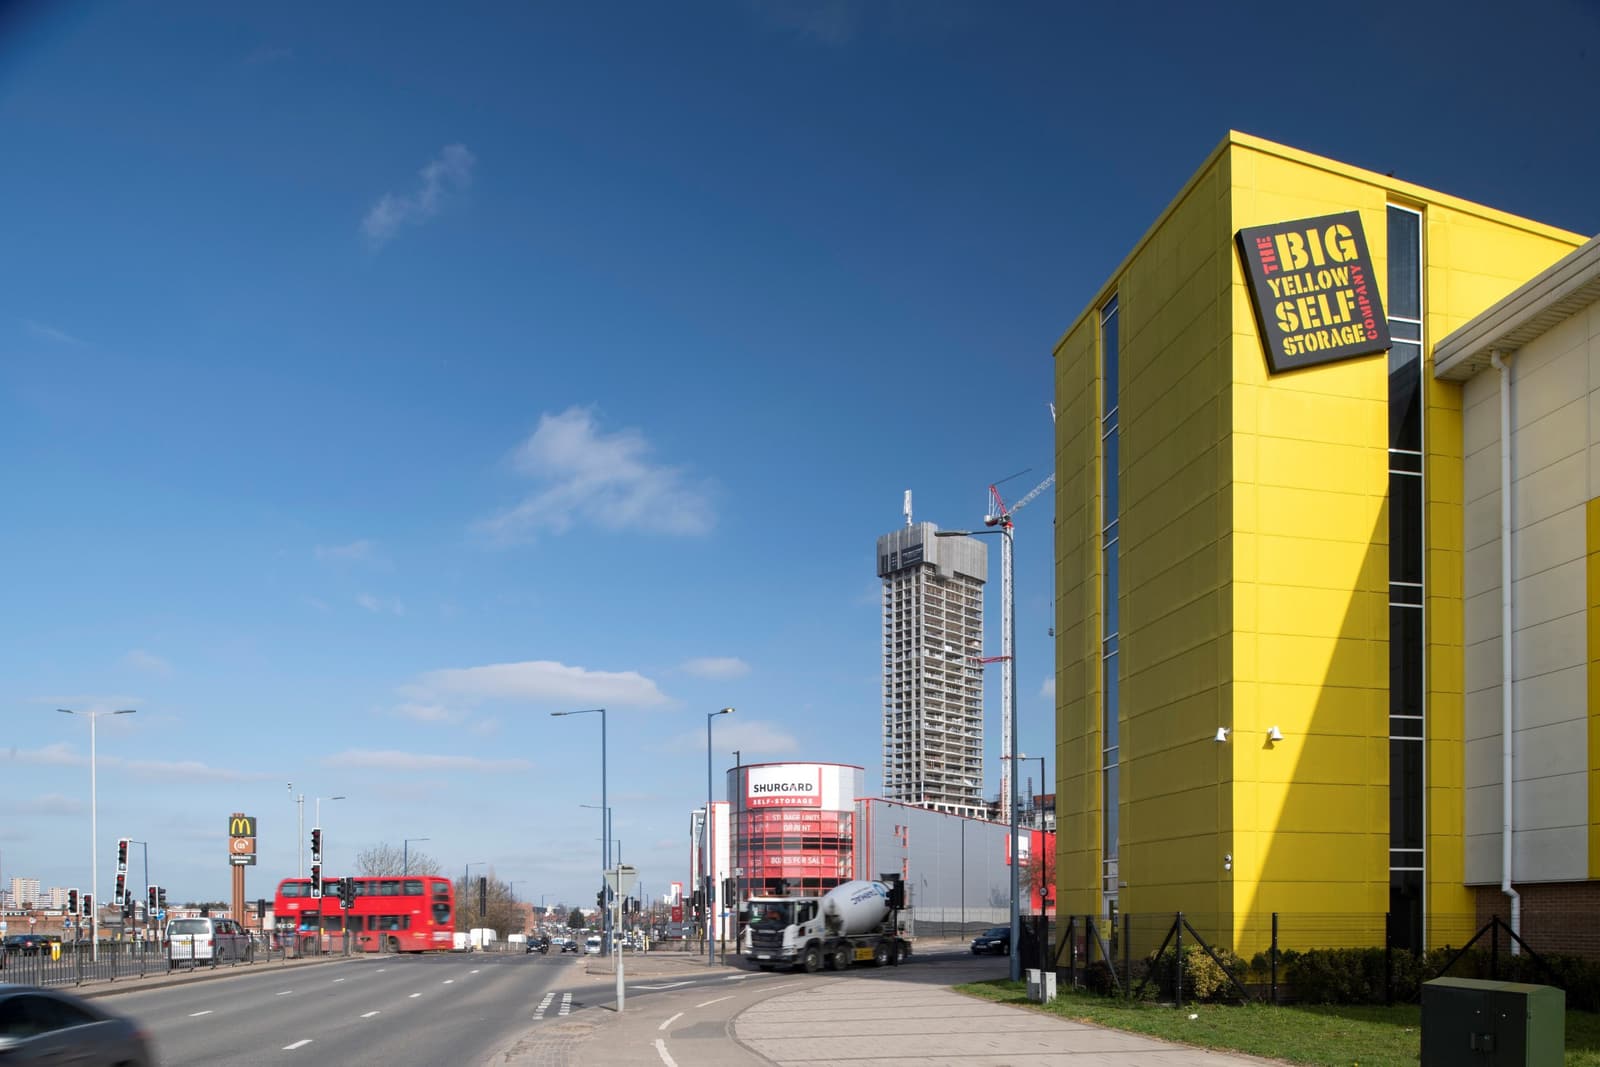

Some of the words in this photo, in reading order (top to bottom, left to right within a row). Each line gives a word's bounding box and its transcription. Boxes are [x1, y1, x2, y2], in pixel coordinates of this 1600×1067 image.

[1255, 235, 1279, 275] THE
[1274, 224, 1359, 272] BIG
[1266, 265, 1350, 298] YELLOW
[1275, 289, 1355, 333] SELF
[1350, 264, 1378, 341] COMPANY
[1282, 323, 1367, 357] STORAGE
[753, 783, 813, 793] SHURGARD
[771, 856, 793, 864] BOES
